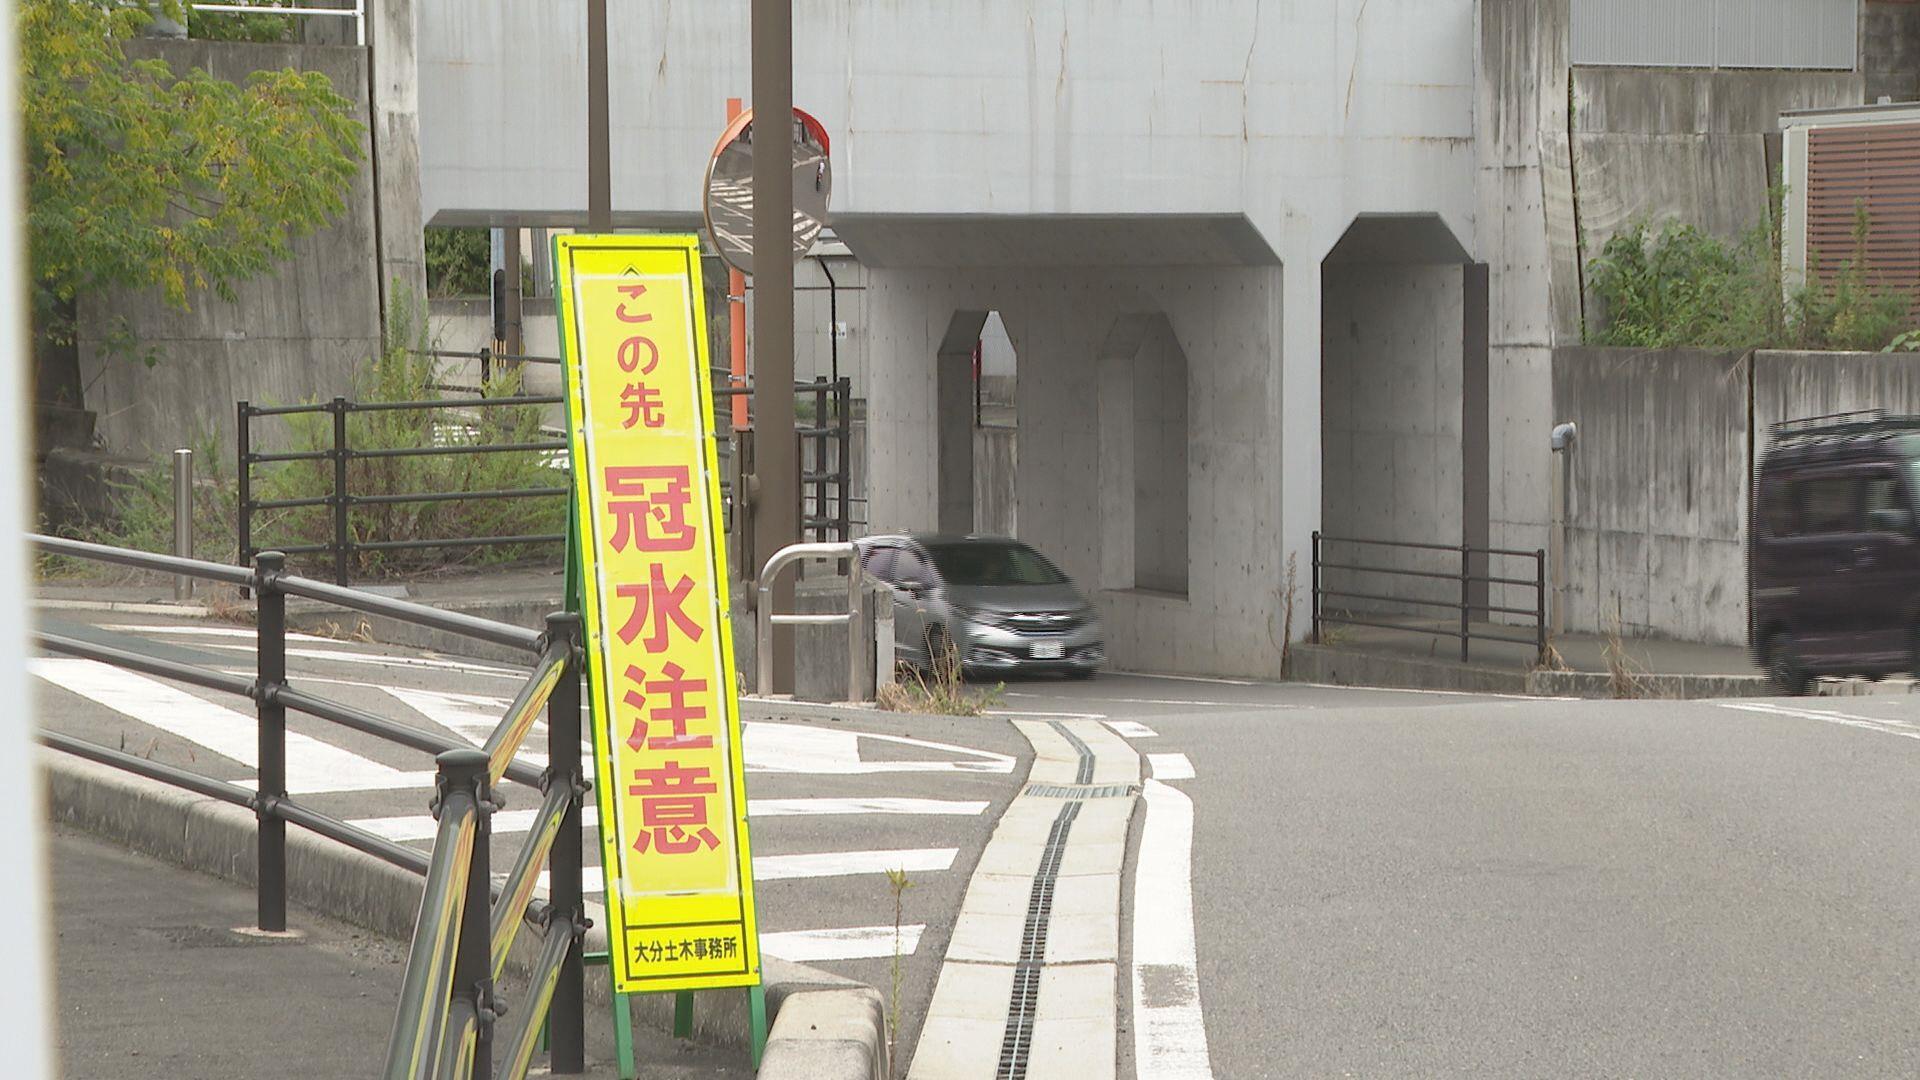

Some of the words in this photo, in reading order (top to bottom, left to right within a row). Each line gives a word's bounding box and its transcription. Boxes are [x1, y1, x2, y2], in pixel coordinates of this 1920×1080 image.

[616, 284, 665, 428] この先
[605, 466, 721, 857] 冠水注意
[634, 937, 737, 963] 大分土木事務所
